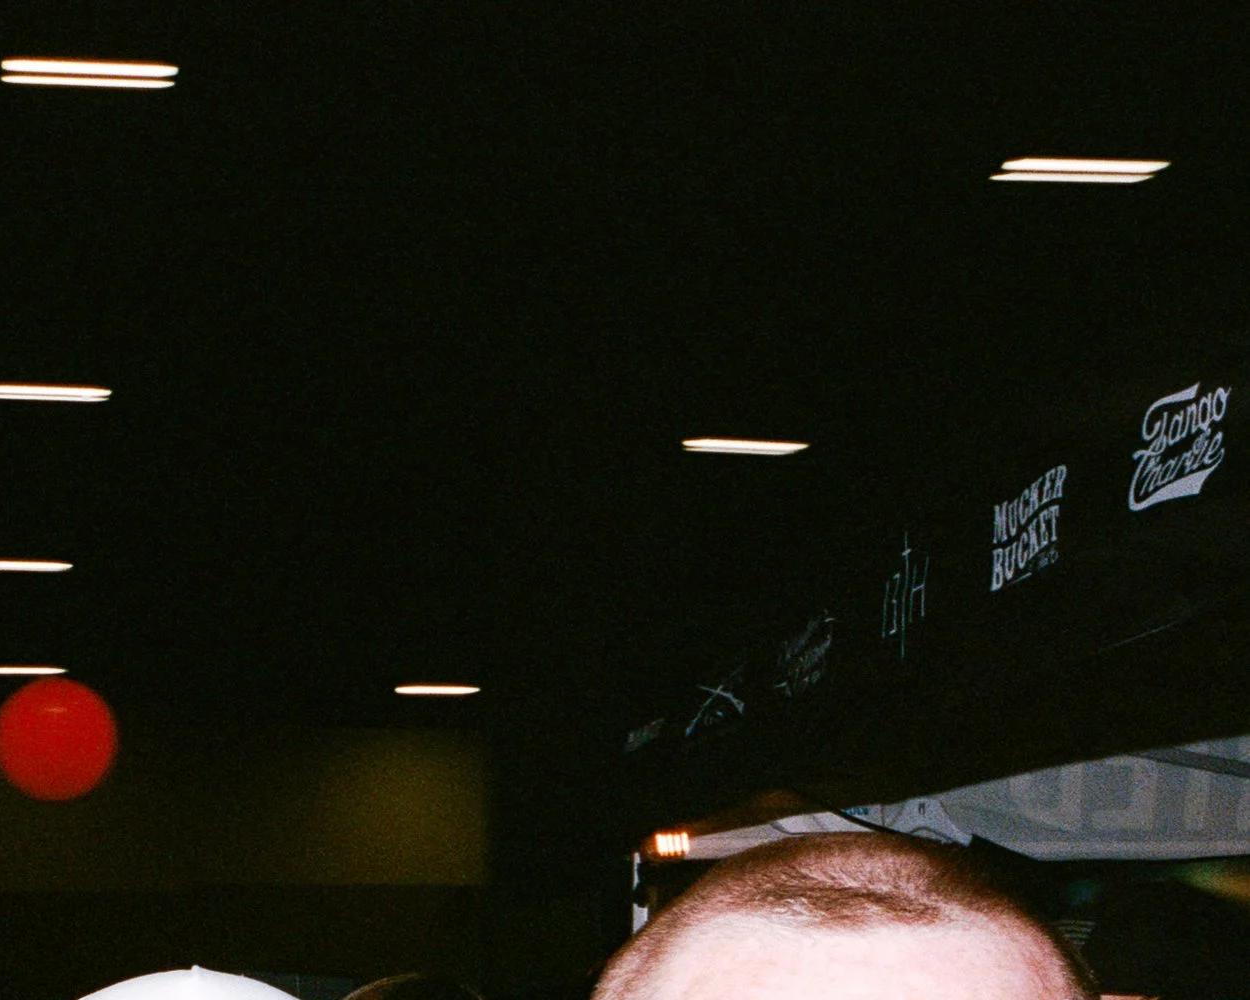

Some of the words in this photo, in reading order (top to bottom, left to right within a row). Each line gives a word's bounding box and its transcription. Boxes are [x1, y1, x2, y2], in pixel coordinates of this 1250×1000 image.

[1142, 382, 1231, 453] Tango
[992, 464, 1068, 545] MUCKER
[989, 504, 1060, 592] BUCKET
